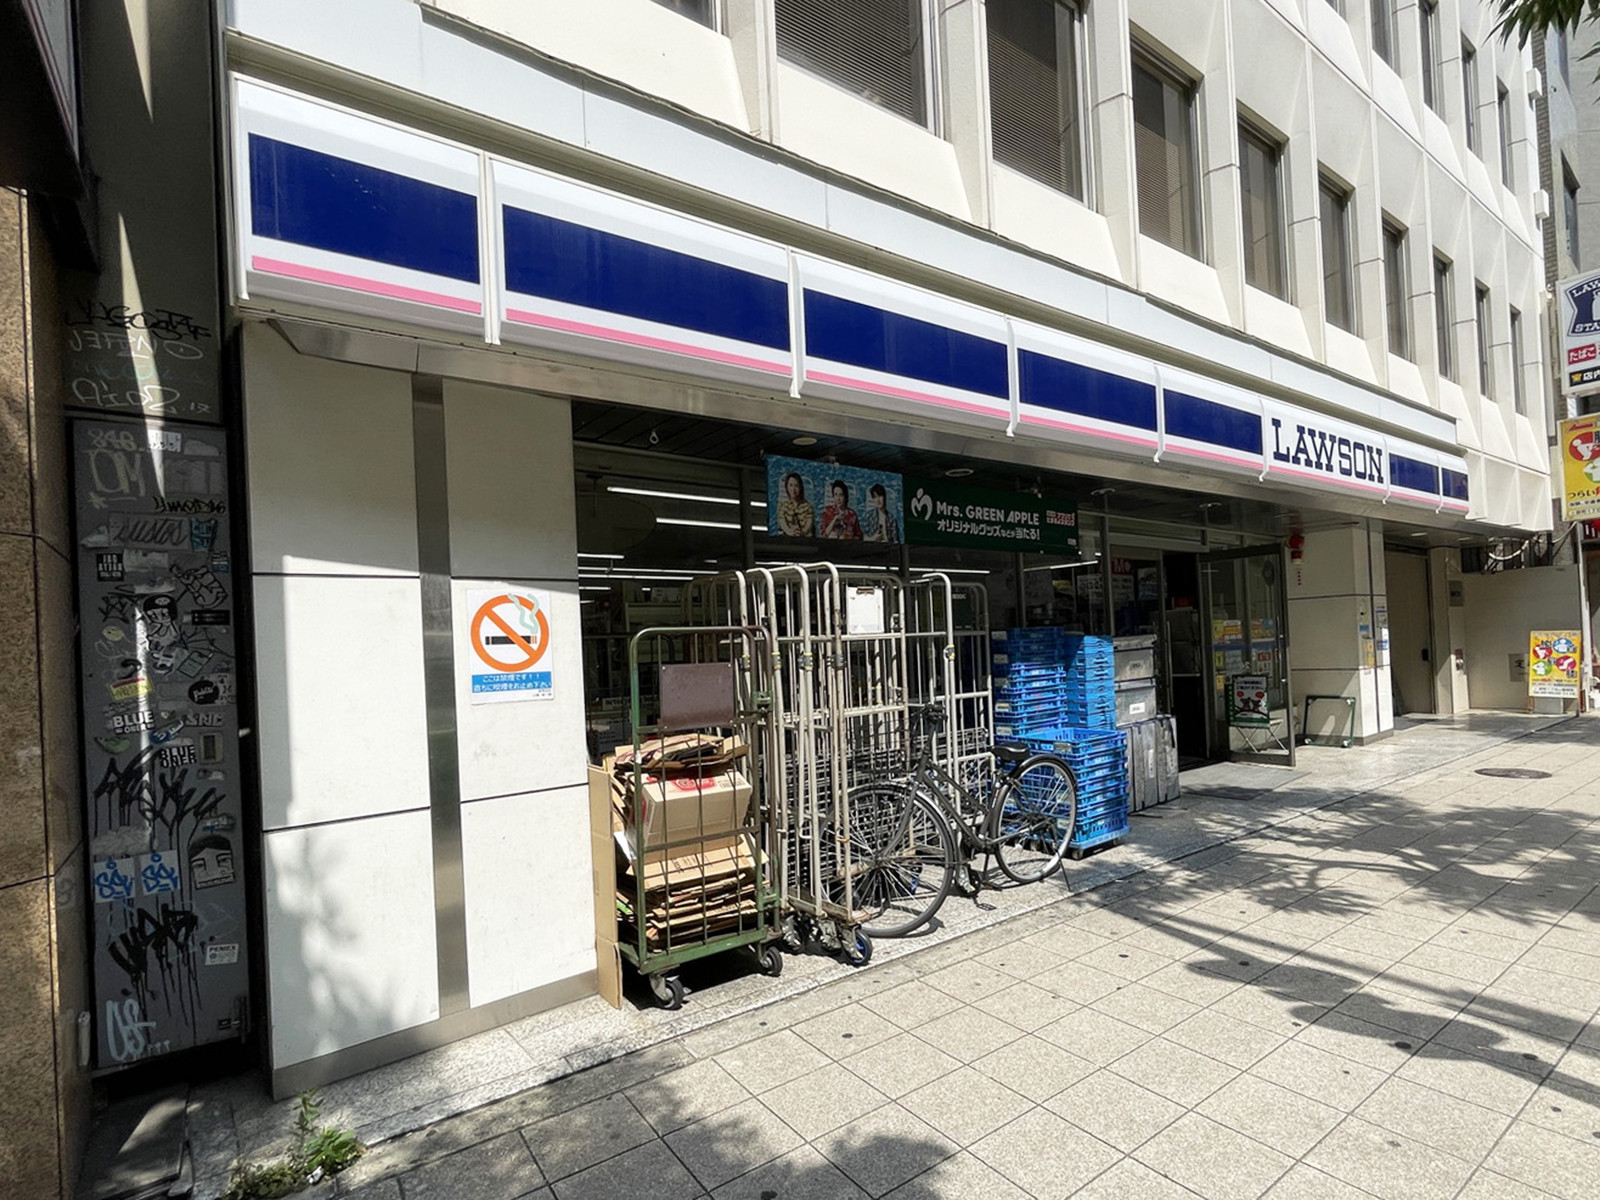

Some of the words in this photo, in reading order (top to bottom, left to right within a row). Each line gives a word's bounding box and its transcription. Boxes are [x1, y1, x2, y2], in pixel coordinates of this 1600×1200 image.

[1569, 347, 1595, 362] たばこ
[1271, 417, 1384, 484] LAWSON
[937, 501, 963, 517] Mrs.
[966, 505, 1005, 522] GREEN
[1006, 511, 1040, 525] APPLE
[112, 711, 154, 728] BLUE
[159, 745, 196, 760] BLUE
[160, 754, 197, 768] ONER
